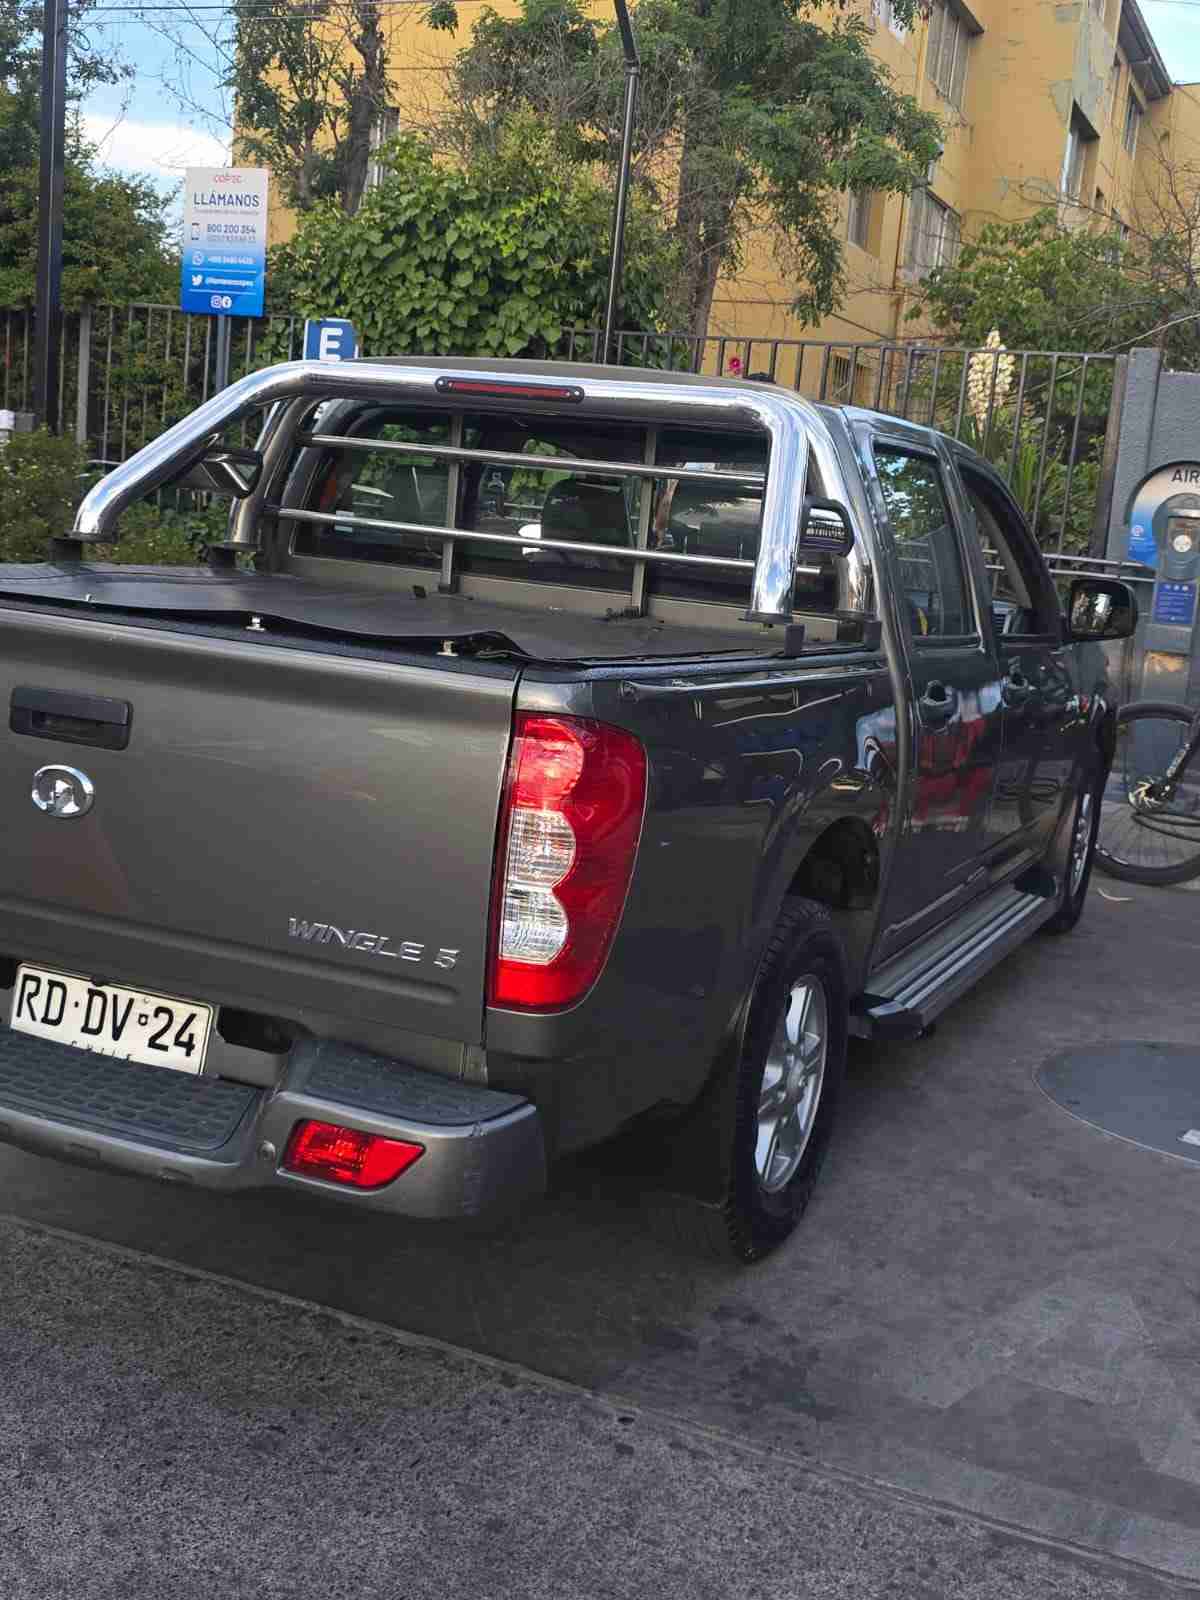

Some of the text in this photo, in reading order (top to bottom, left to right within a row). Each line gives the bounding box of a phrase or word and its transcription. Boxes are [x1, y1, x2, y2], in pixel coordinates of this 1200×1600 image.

[193, 190, 260, 208] LLÁMANOS
[223, 224, 240, 235] 200
[319, 327, 344, 361] E
[1171, 469, 1200, 483] AIR
[288, 916, 460, 969] WINGLE 5
